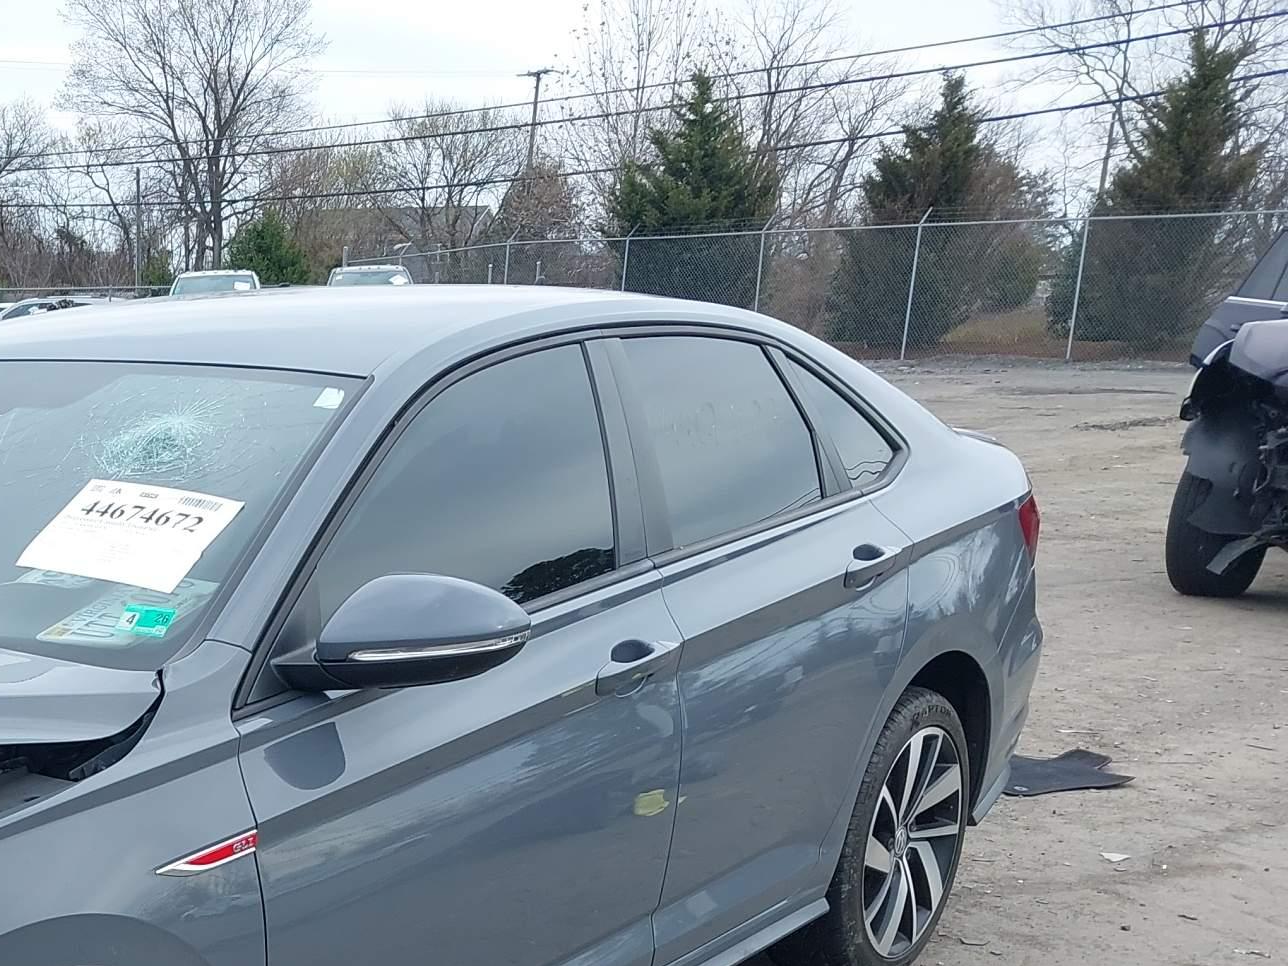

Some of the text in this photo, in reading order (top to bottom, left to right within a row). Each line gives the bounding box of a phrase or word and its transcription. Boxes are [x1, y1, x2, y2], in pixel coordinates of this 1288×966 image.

[81, 501, 203, 532] 44674672
[126, 613, 170, 624] 4 26
